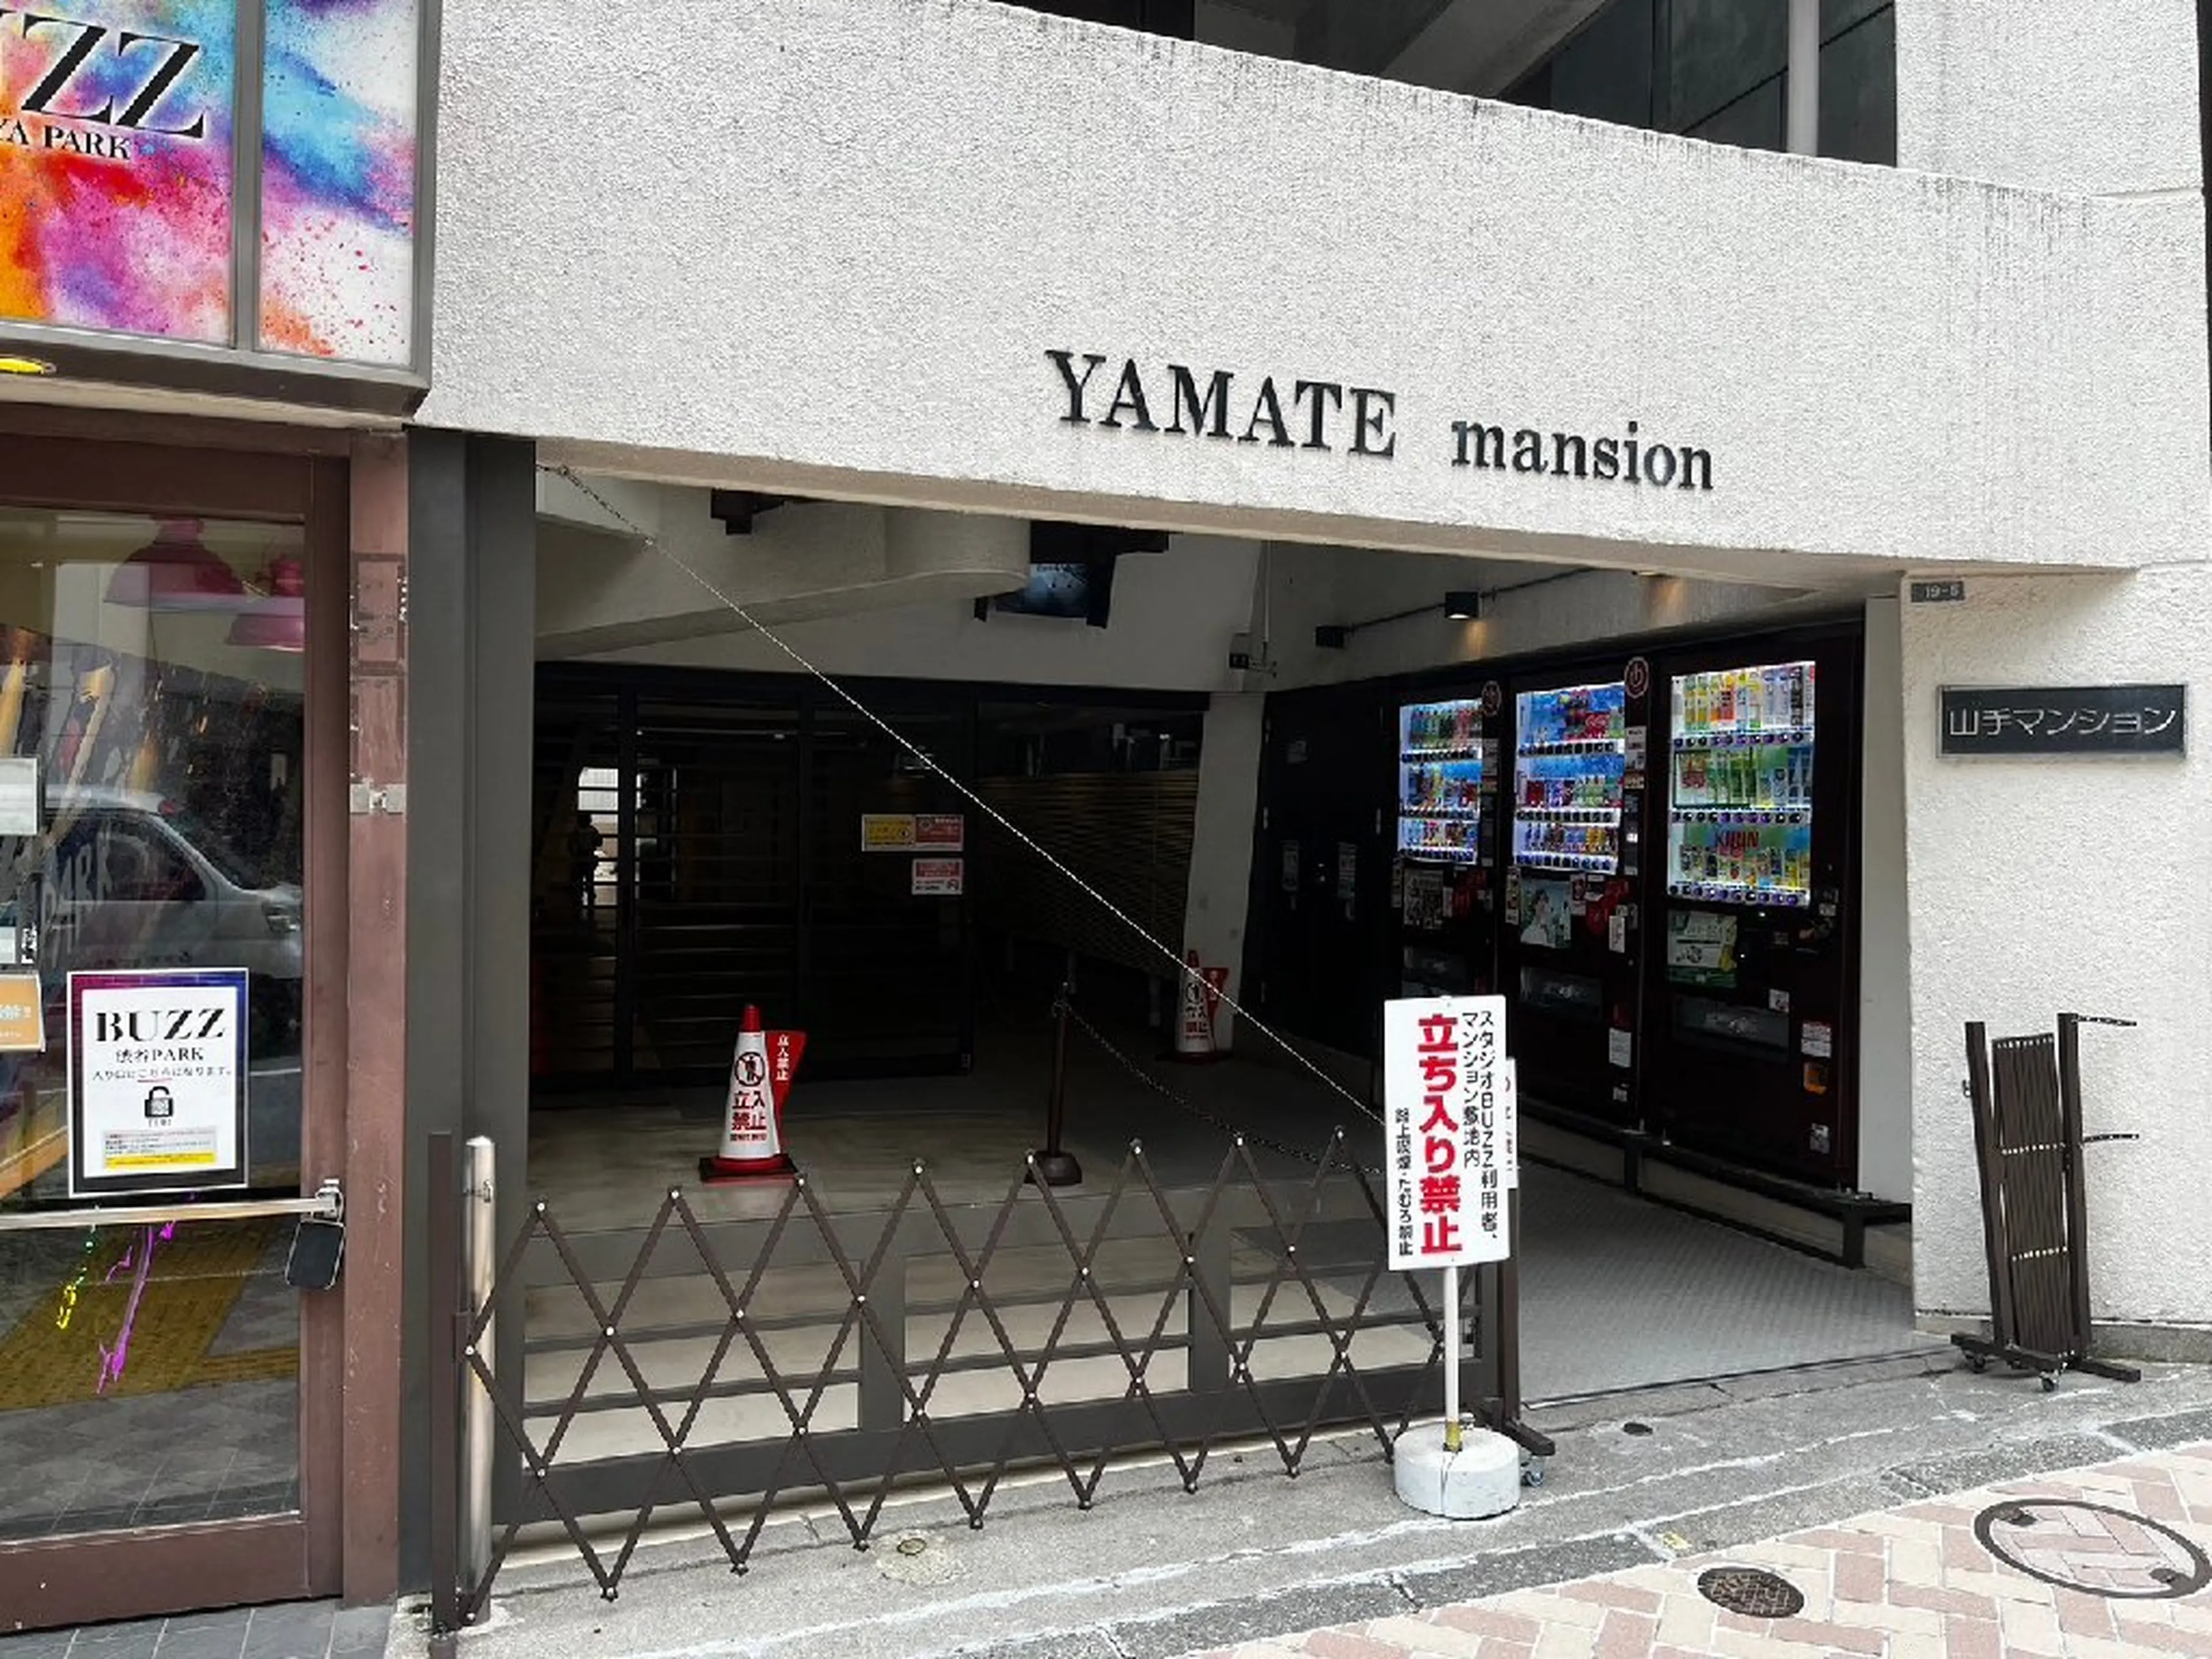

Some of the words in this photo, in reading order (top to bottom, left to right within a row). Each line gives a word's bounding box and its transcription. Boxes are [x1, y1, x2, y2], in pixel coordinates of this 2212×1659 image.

[0, 9, 204, 138] ZZ
[44, 124, 131, 160] PARK
[1045, 349, 1396, 457] YAMATE
[1450, 421, 1714, 490] mansion
[1949, 707, 2176, 736] 山手マンション
[1715, 830, 1760, 848] KIRIN
[95, 1007, 226, 1042] BUZZ
[732, 1090, 766, 1109] 立入
[732, 1112, 767, 1131] 禁止
[1417, 1013, 1463, 1255] 立ち入り禁止
